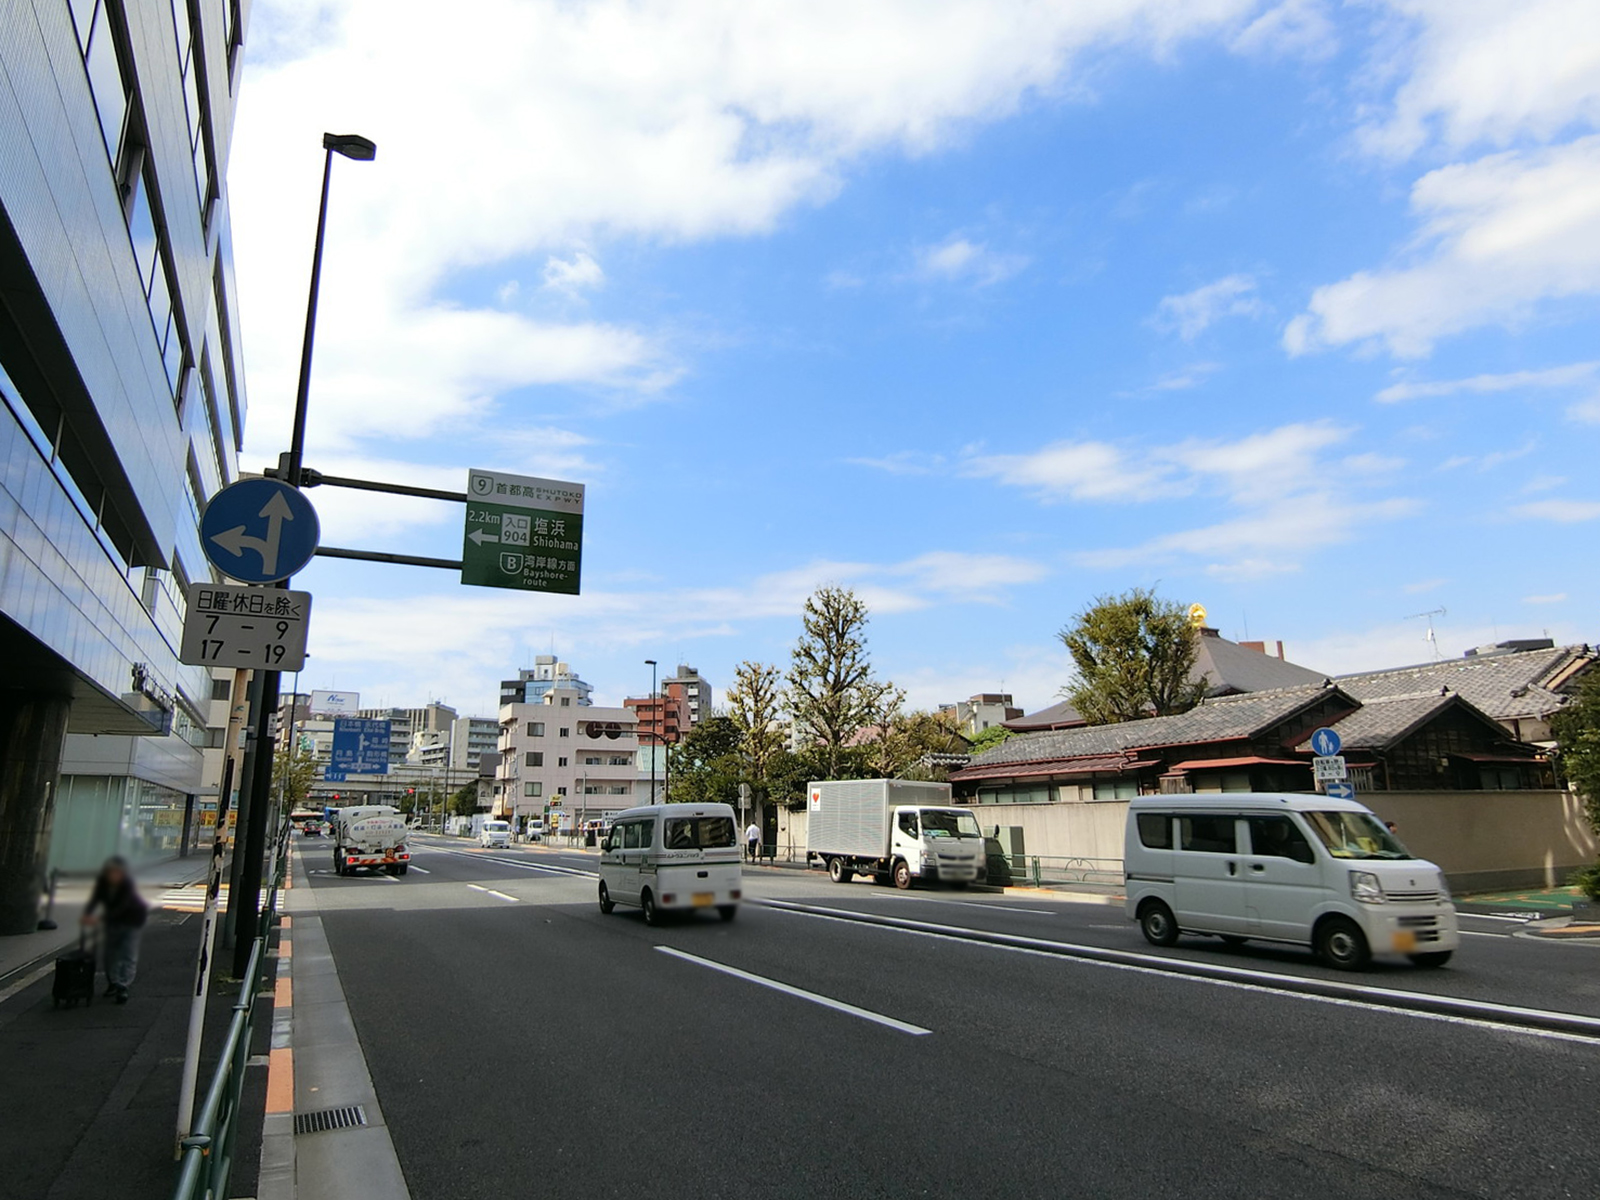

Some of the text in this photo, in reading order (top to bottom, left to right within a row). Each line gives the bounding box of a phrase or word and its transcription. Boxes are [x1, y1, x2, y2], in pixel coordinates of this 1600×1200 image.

[478, 479, 487, 492] 9
[496, 483, 534, 499] 首都高
[536, 488, 582, 498] SHUTOKO
[468, 510, 500, 525] 2.2km
[505, 517, 528, 530] 入口
[534, 517, 565, 536] 塩浜
[504, 530, 528, 543] 904
[533, 536, 579, 550] Shiohama
[507, 557, 517, 570] B
[525, 555, 576, 571] 湾岸線方面
[523, 578, 548, 587] route
[205, 615, 220, 635] 7
[276, 620, 290, 640] 9
[201, 639, 224, 660] 17
[265, 644, 286, 664] 19
